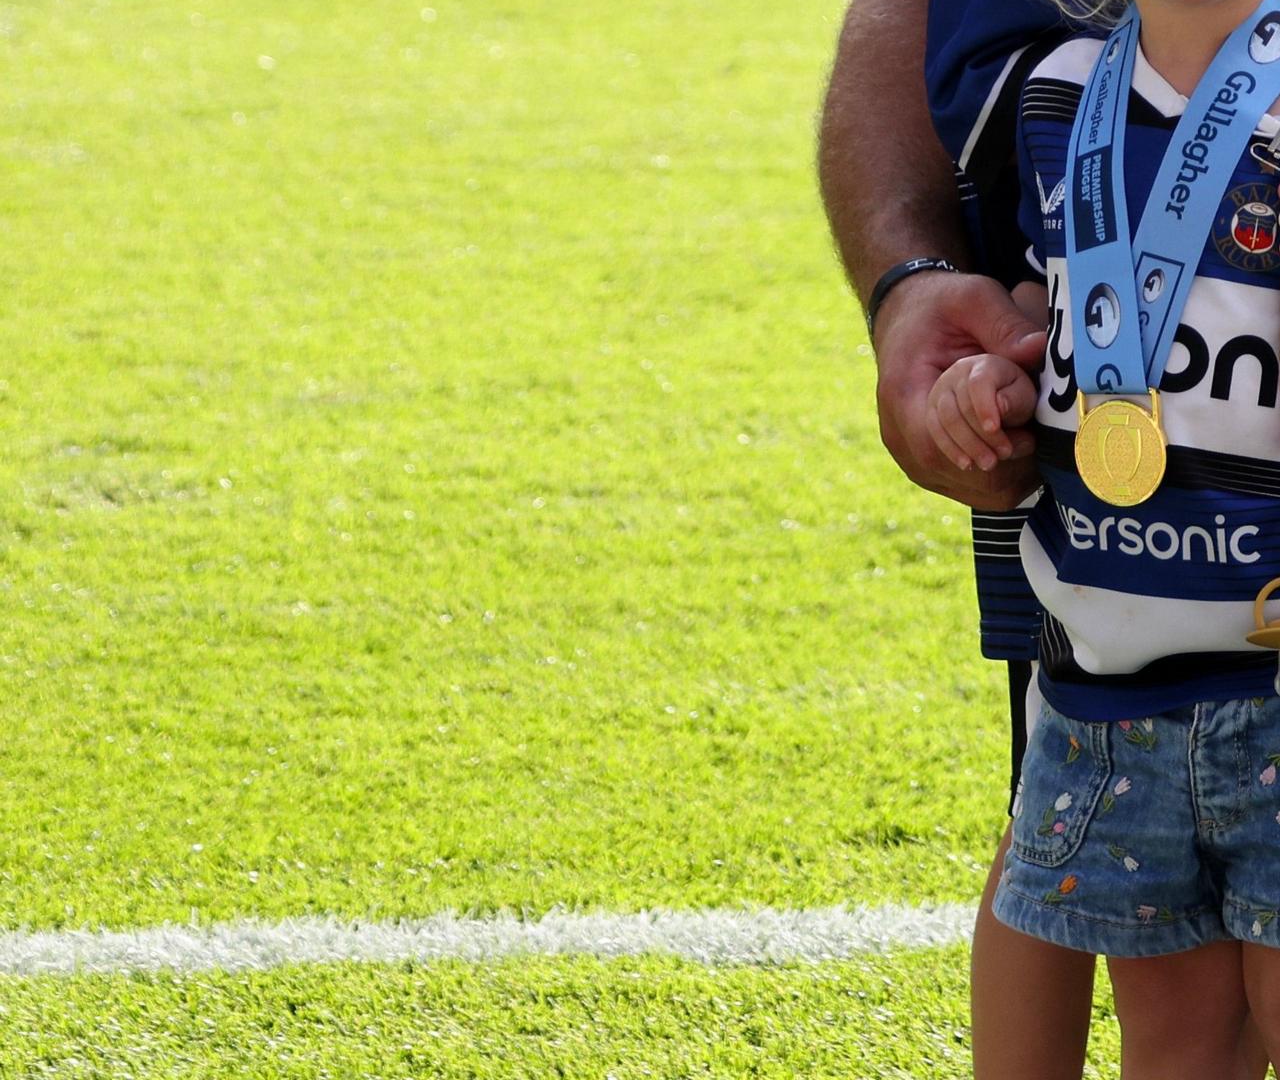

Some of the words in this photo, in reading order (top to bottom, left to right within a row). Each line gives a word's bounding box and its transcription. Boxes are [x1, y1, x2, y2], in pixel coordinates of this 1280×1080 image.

[1088, 71, 1112, 145] Gallagher
[1165, 70, 1257, 221] Gallagher
[1081, 158, 1092, 202] RUGBY
[1092, 153, 1107, 242] PREMIERSHIP
